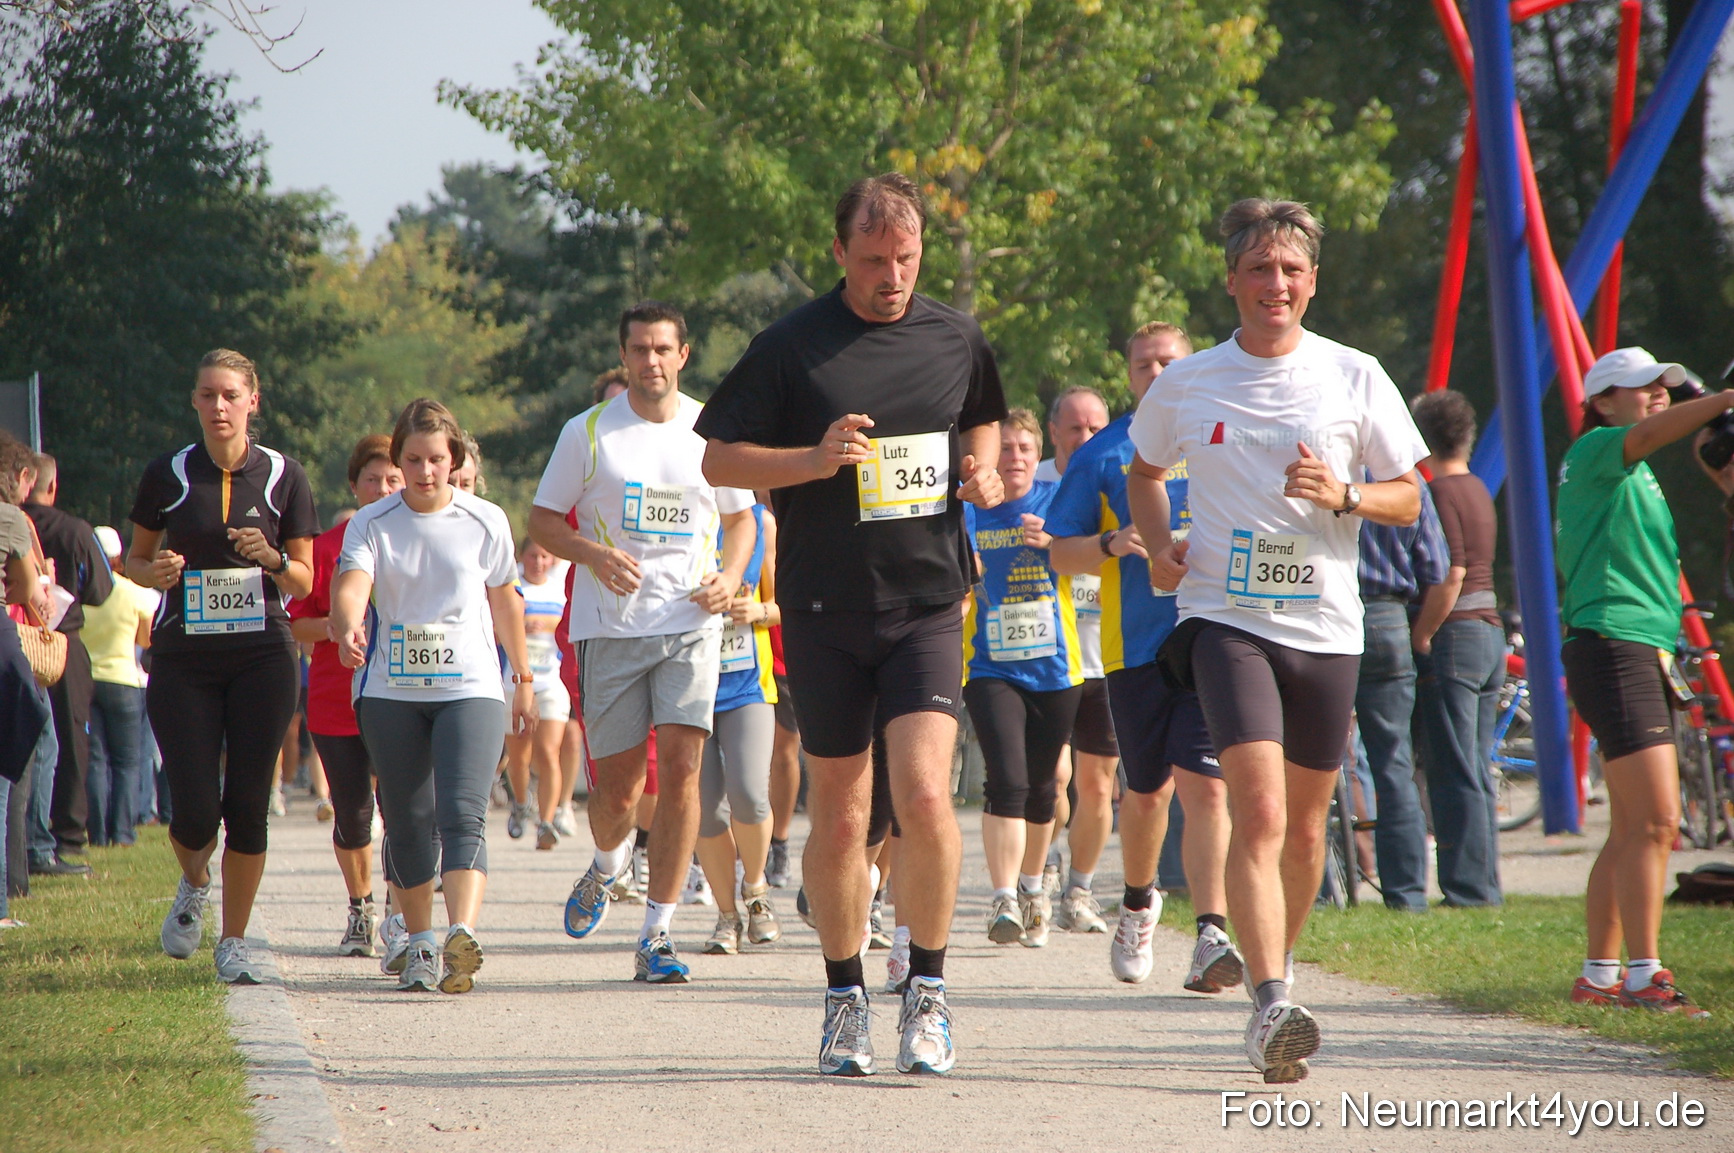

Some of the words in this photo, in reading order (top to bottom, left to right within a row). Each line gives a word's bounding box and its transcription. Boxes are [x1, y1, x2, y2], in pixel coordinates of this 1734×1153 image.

[883, 444, 909, 460] Lutz
[895, 465, 937, 490] 343
[646, 487, 683, 501] Dominic
[646, 505, 690, 524] 3025
[976, 526, 1025, 541] NEUMAR
[1257, 538, 1295, 555] Bernd
[206, 575, 241, 587] Kerstin
[1256, 562, 1315, 584] 3602
[208, 591, 256, 610] 3024
[1004, 609, 1040, 620] Gabriele
[407, 629, 445, 642] Barbara
[1007, 623, 1048, 640] 2512
[393, 647, 398, 656] C
[408, 648, 455, 665] 3612
